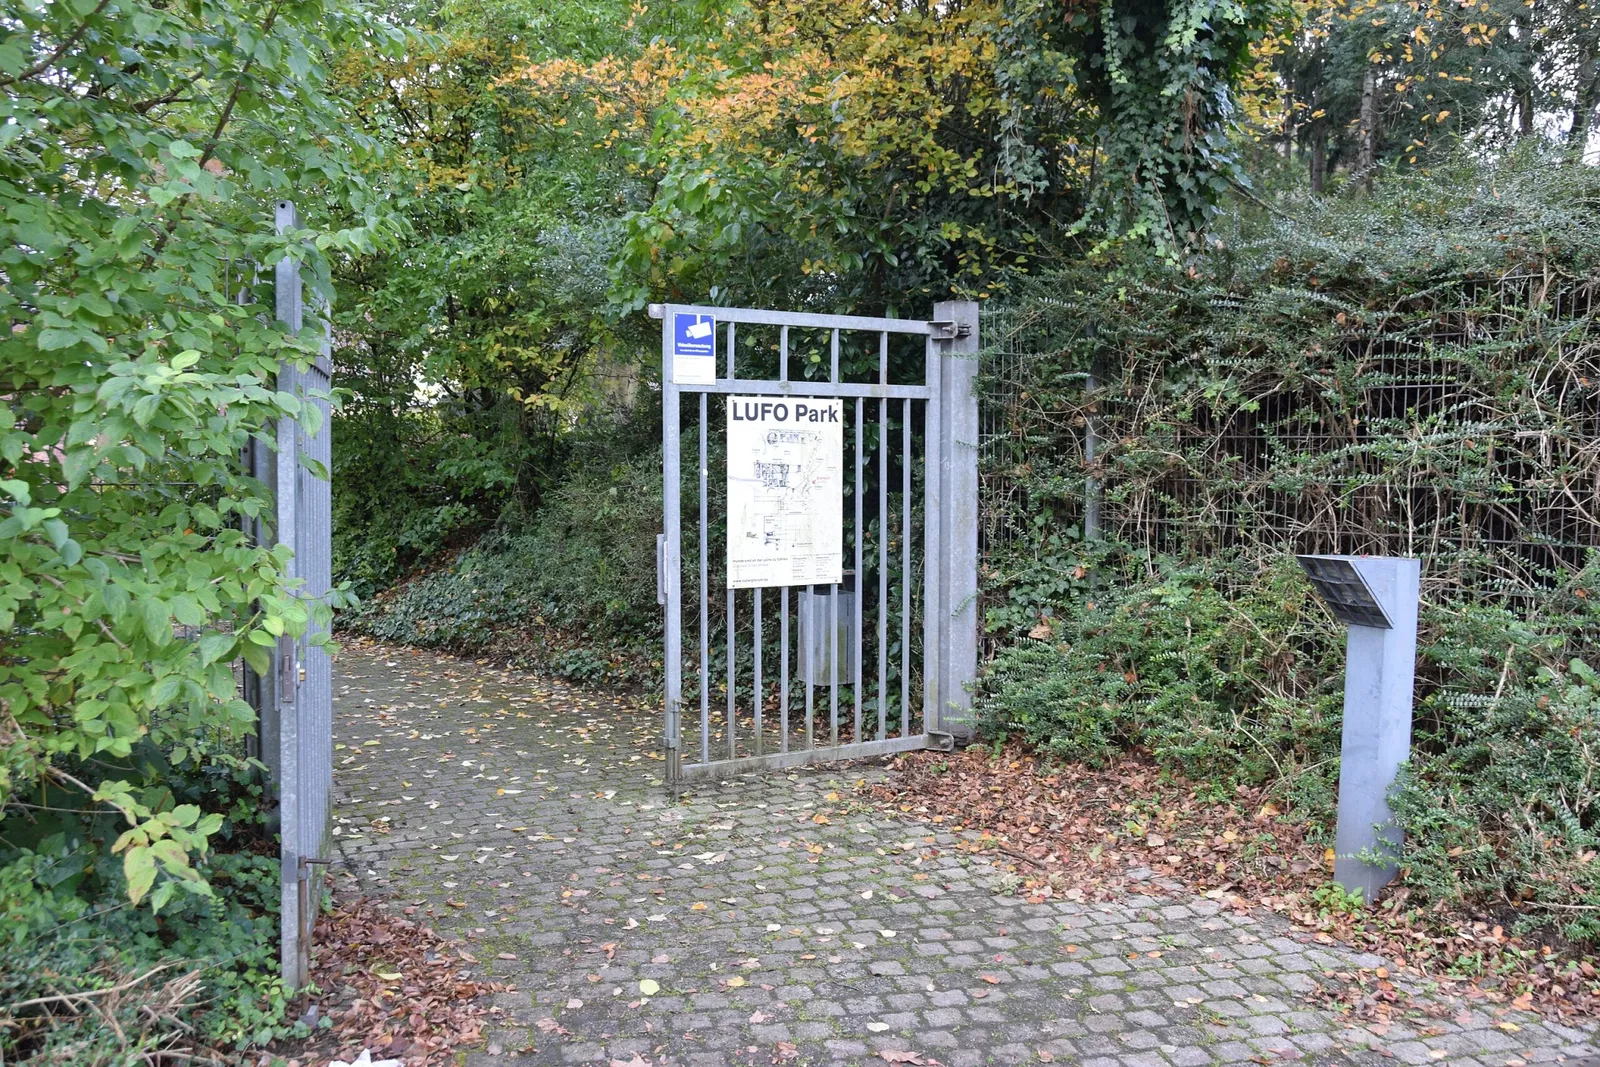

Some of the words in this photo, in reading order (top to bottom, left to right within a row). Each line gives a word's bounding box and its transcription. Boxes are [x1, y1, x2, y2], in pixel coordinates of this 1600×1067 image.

[677, 342, 712, 350] Videoüberwachung
[733, 402, 789, 422] LUFO
[795, 404, 839, 423] Park
